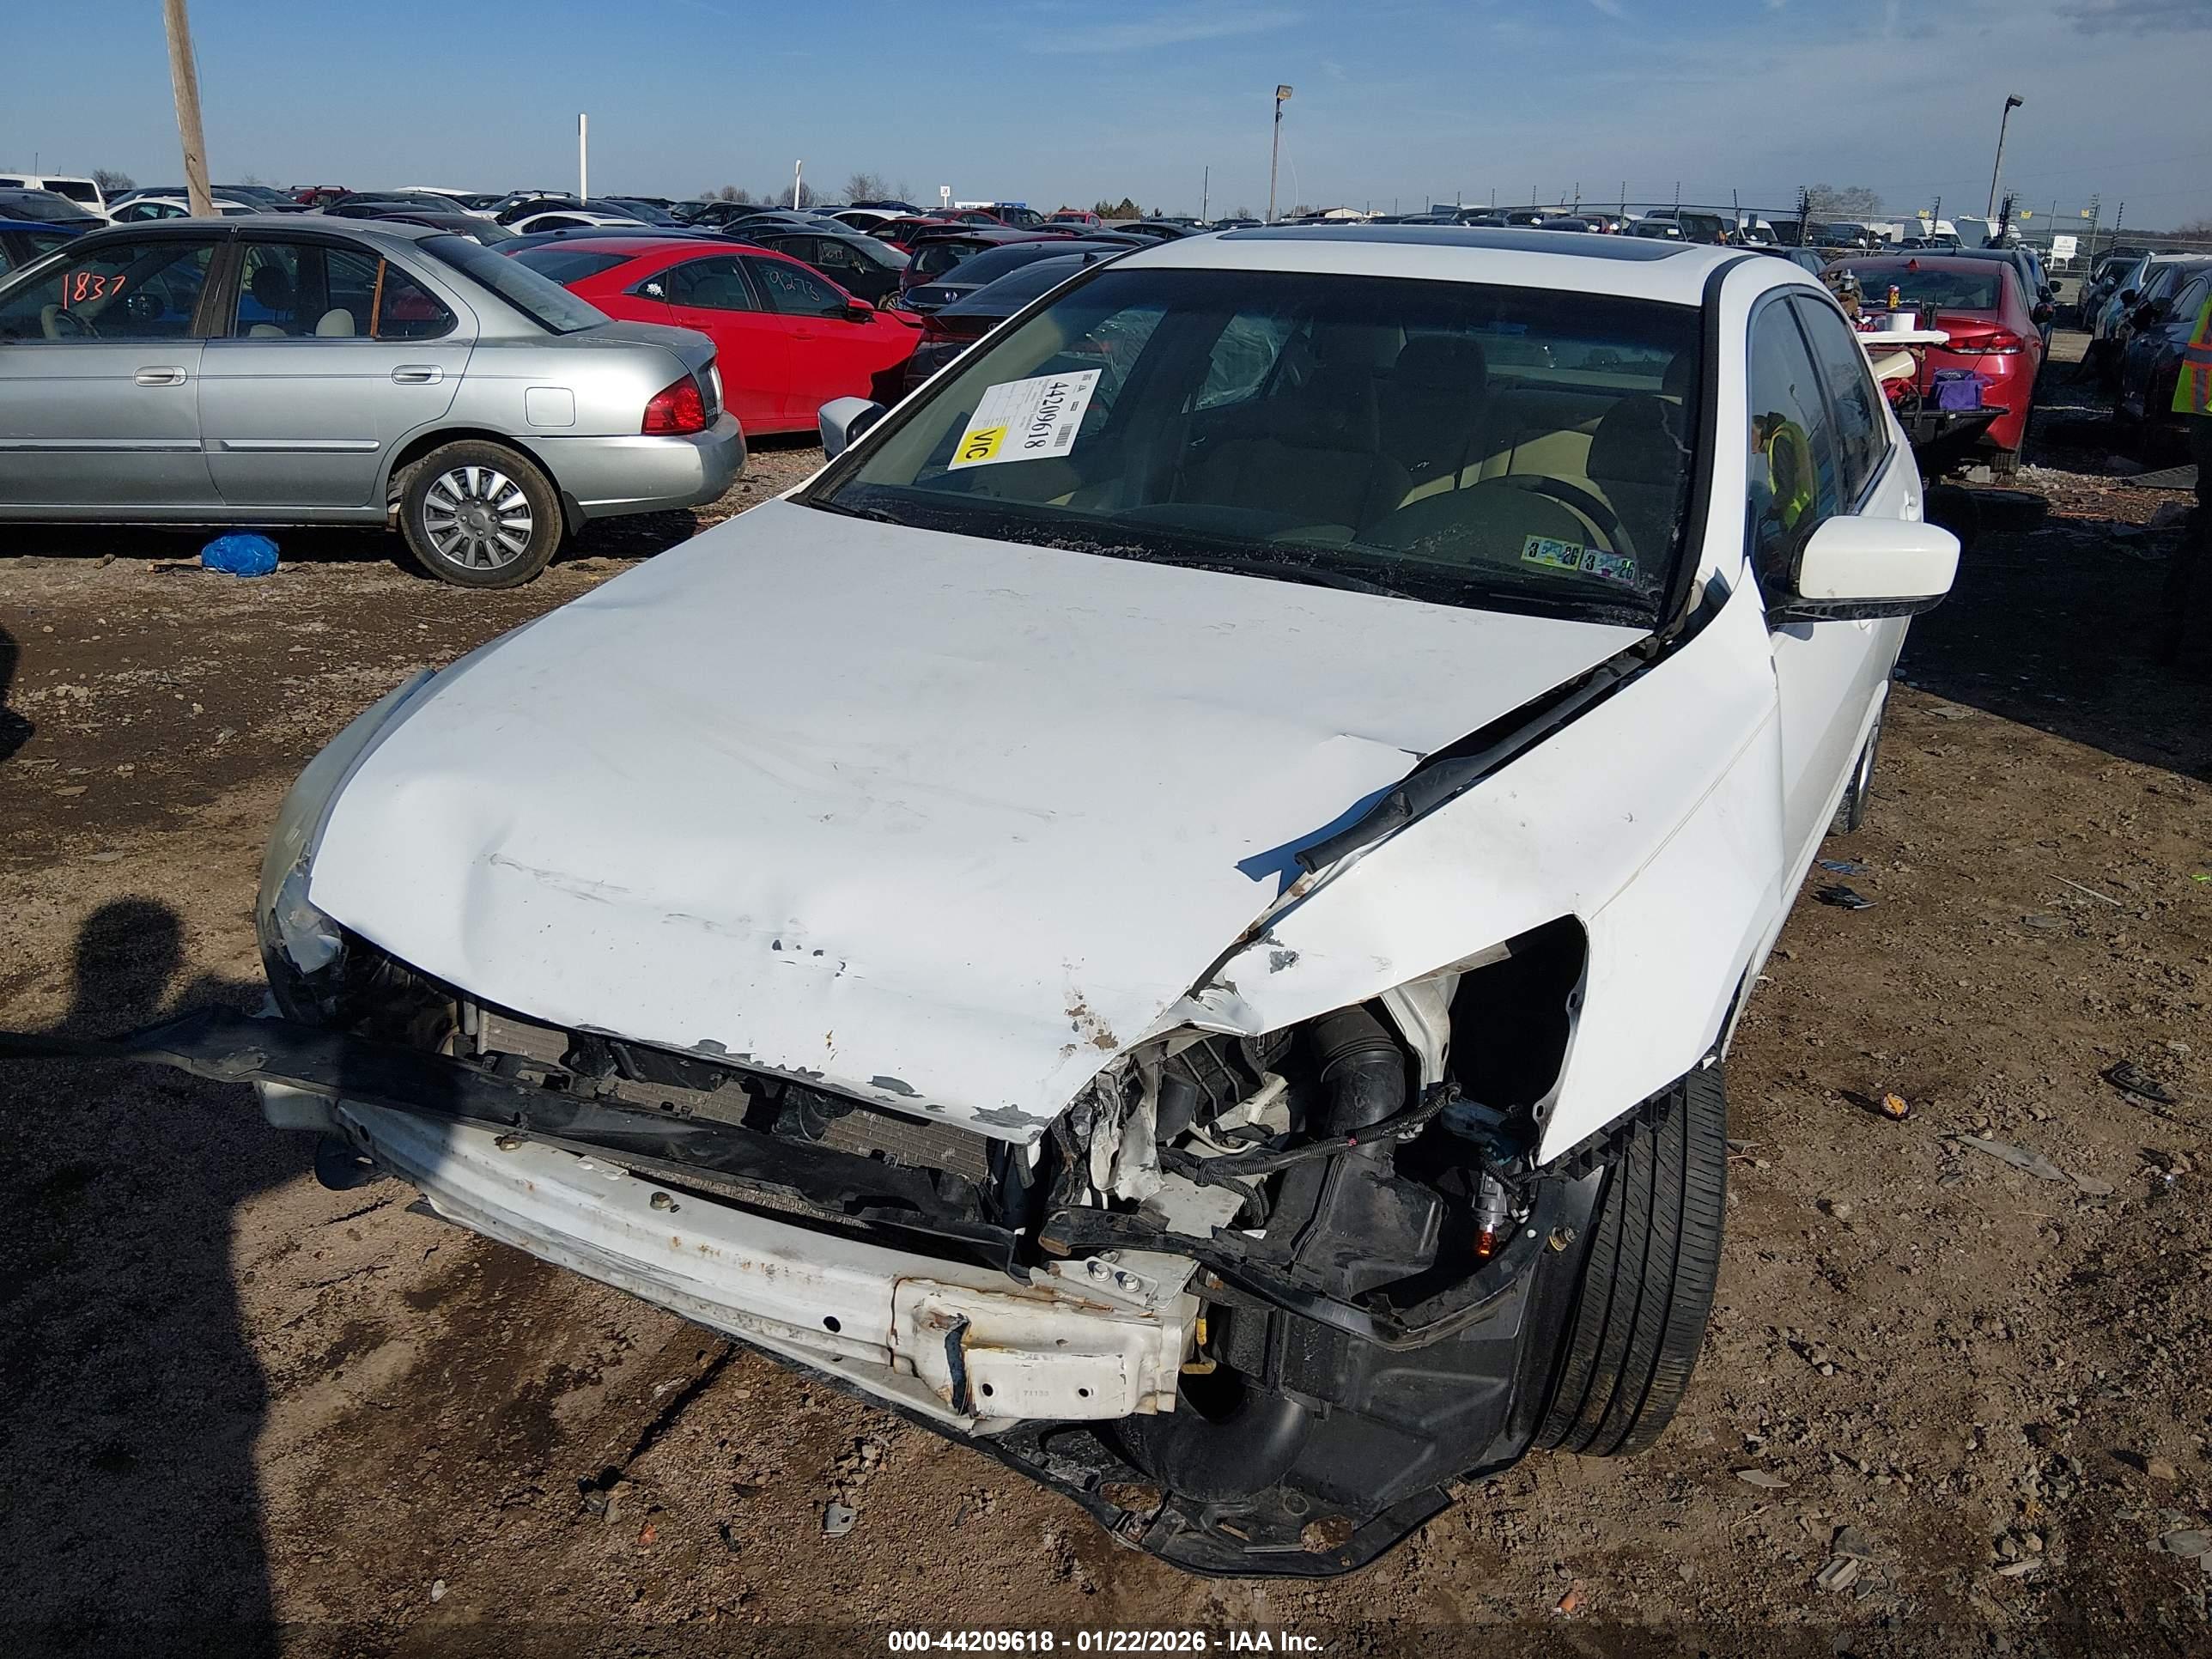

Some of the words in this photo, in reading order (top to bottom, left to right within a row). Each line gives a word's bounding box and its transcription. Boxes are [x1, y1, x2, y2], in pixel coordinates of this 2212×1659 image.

[62, 274, 126, 310] 1837
[769, 270, 820, 301] 9273
[1024, 381, 1070, 449] 44209618
[965, 429, 997, 459] VIC
[1528, 542, 1540, 557] 3
[1563, 546, 1579, 565] 26
[1585, 554, 1595, 571] 3
[1618, 560, 1635, 579] 26
